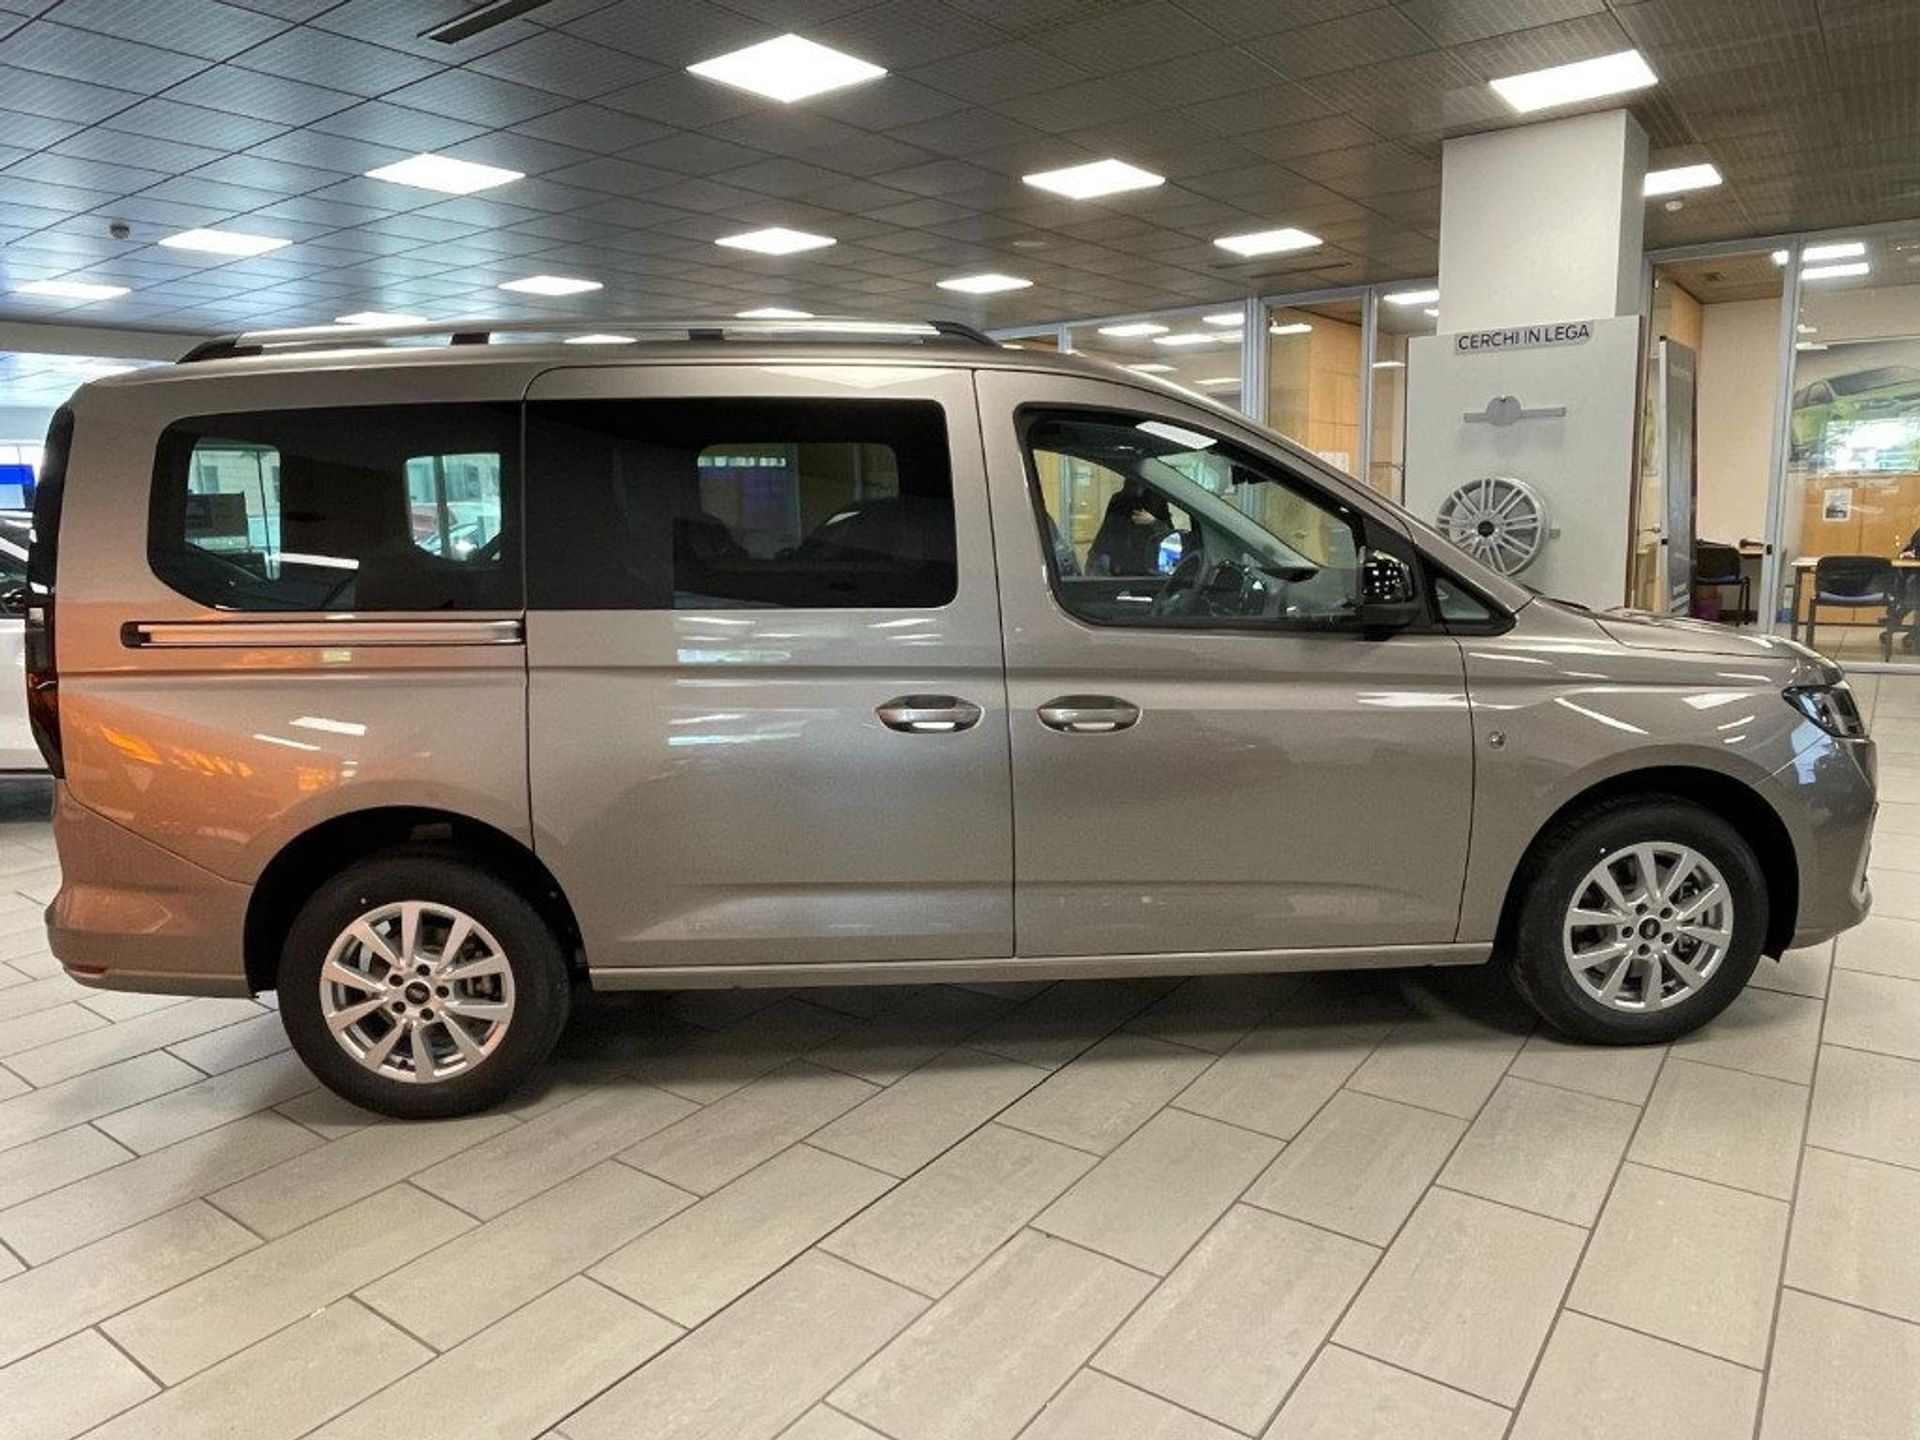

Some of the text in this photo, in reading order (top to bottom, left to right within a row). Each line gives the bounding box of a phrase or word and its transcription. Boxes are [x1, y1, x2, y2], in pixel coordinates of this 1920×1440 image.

[1458, 324, 1590, 350] CERCHI IN LEGA
